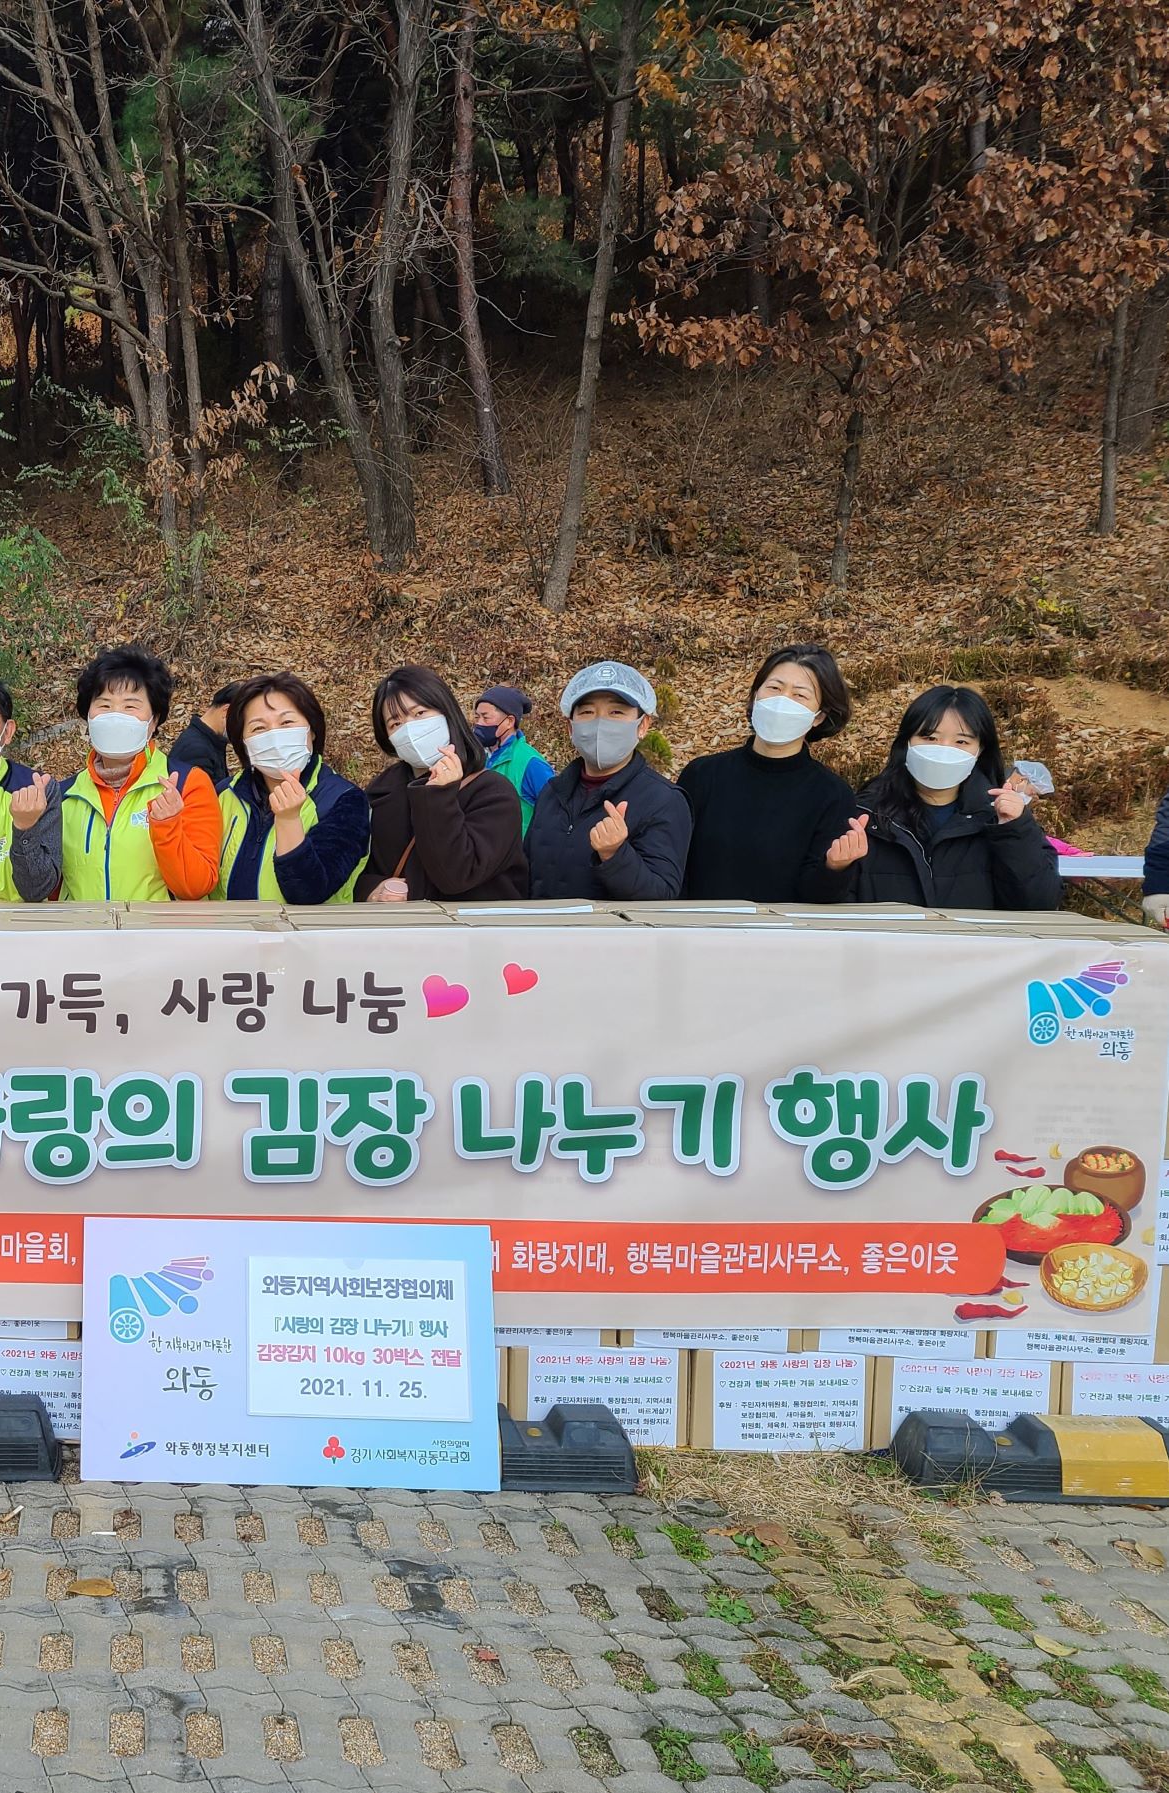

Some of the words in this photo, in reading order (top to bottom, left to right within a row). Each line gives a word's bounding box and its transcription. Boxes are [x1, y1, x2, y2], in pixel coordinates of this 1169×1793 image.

[0, 972, 130, 1036] 가득,
[160, 971, 275, 1033] 사랑
[302, 971, 407, 1035] 나눔
[230, 1075, 428, 1179] 김장
[458, 1078, 737, 1177] 나누기
[771, 1072, 986, 1184] 행사
[511, 1240, 615, 1276] 화랑지대,
[626, 1241, 850, 1277] 행복마을관리사무소,
[860, 1242, 959, 1276] 좋은이웃
[261, 1274, 454, 1301] 와동지역사회보장협의체
[329, 1317, 359, 1336] 김장
[419, 1320, 449, 1338] 행사
[148, 1331, 162, 1354] 한
[256, 1343, 317, 1363] 김장김치
[323, 1346, 366, 1366] 10kg
[372, 1347, 425, 1367] 30박스
[430, 1349, 462, 1368] 전달
[161, 1366, 219, 1401] 와동
[299, 1377, 352, 1397] 2021.
[361, 1379, 390, 1398] 11.
[398, 1381, 428, 1400] 25.
[165, 1441, 270, 1458] 와동행정복지센터
